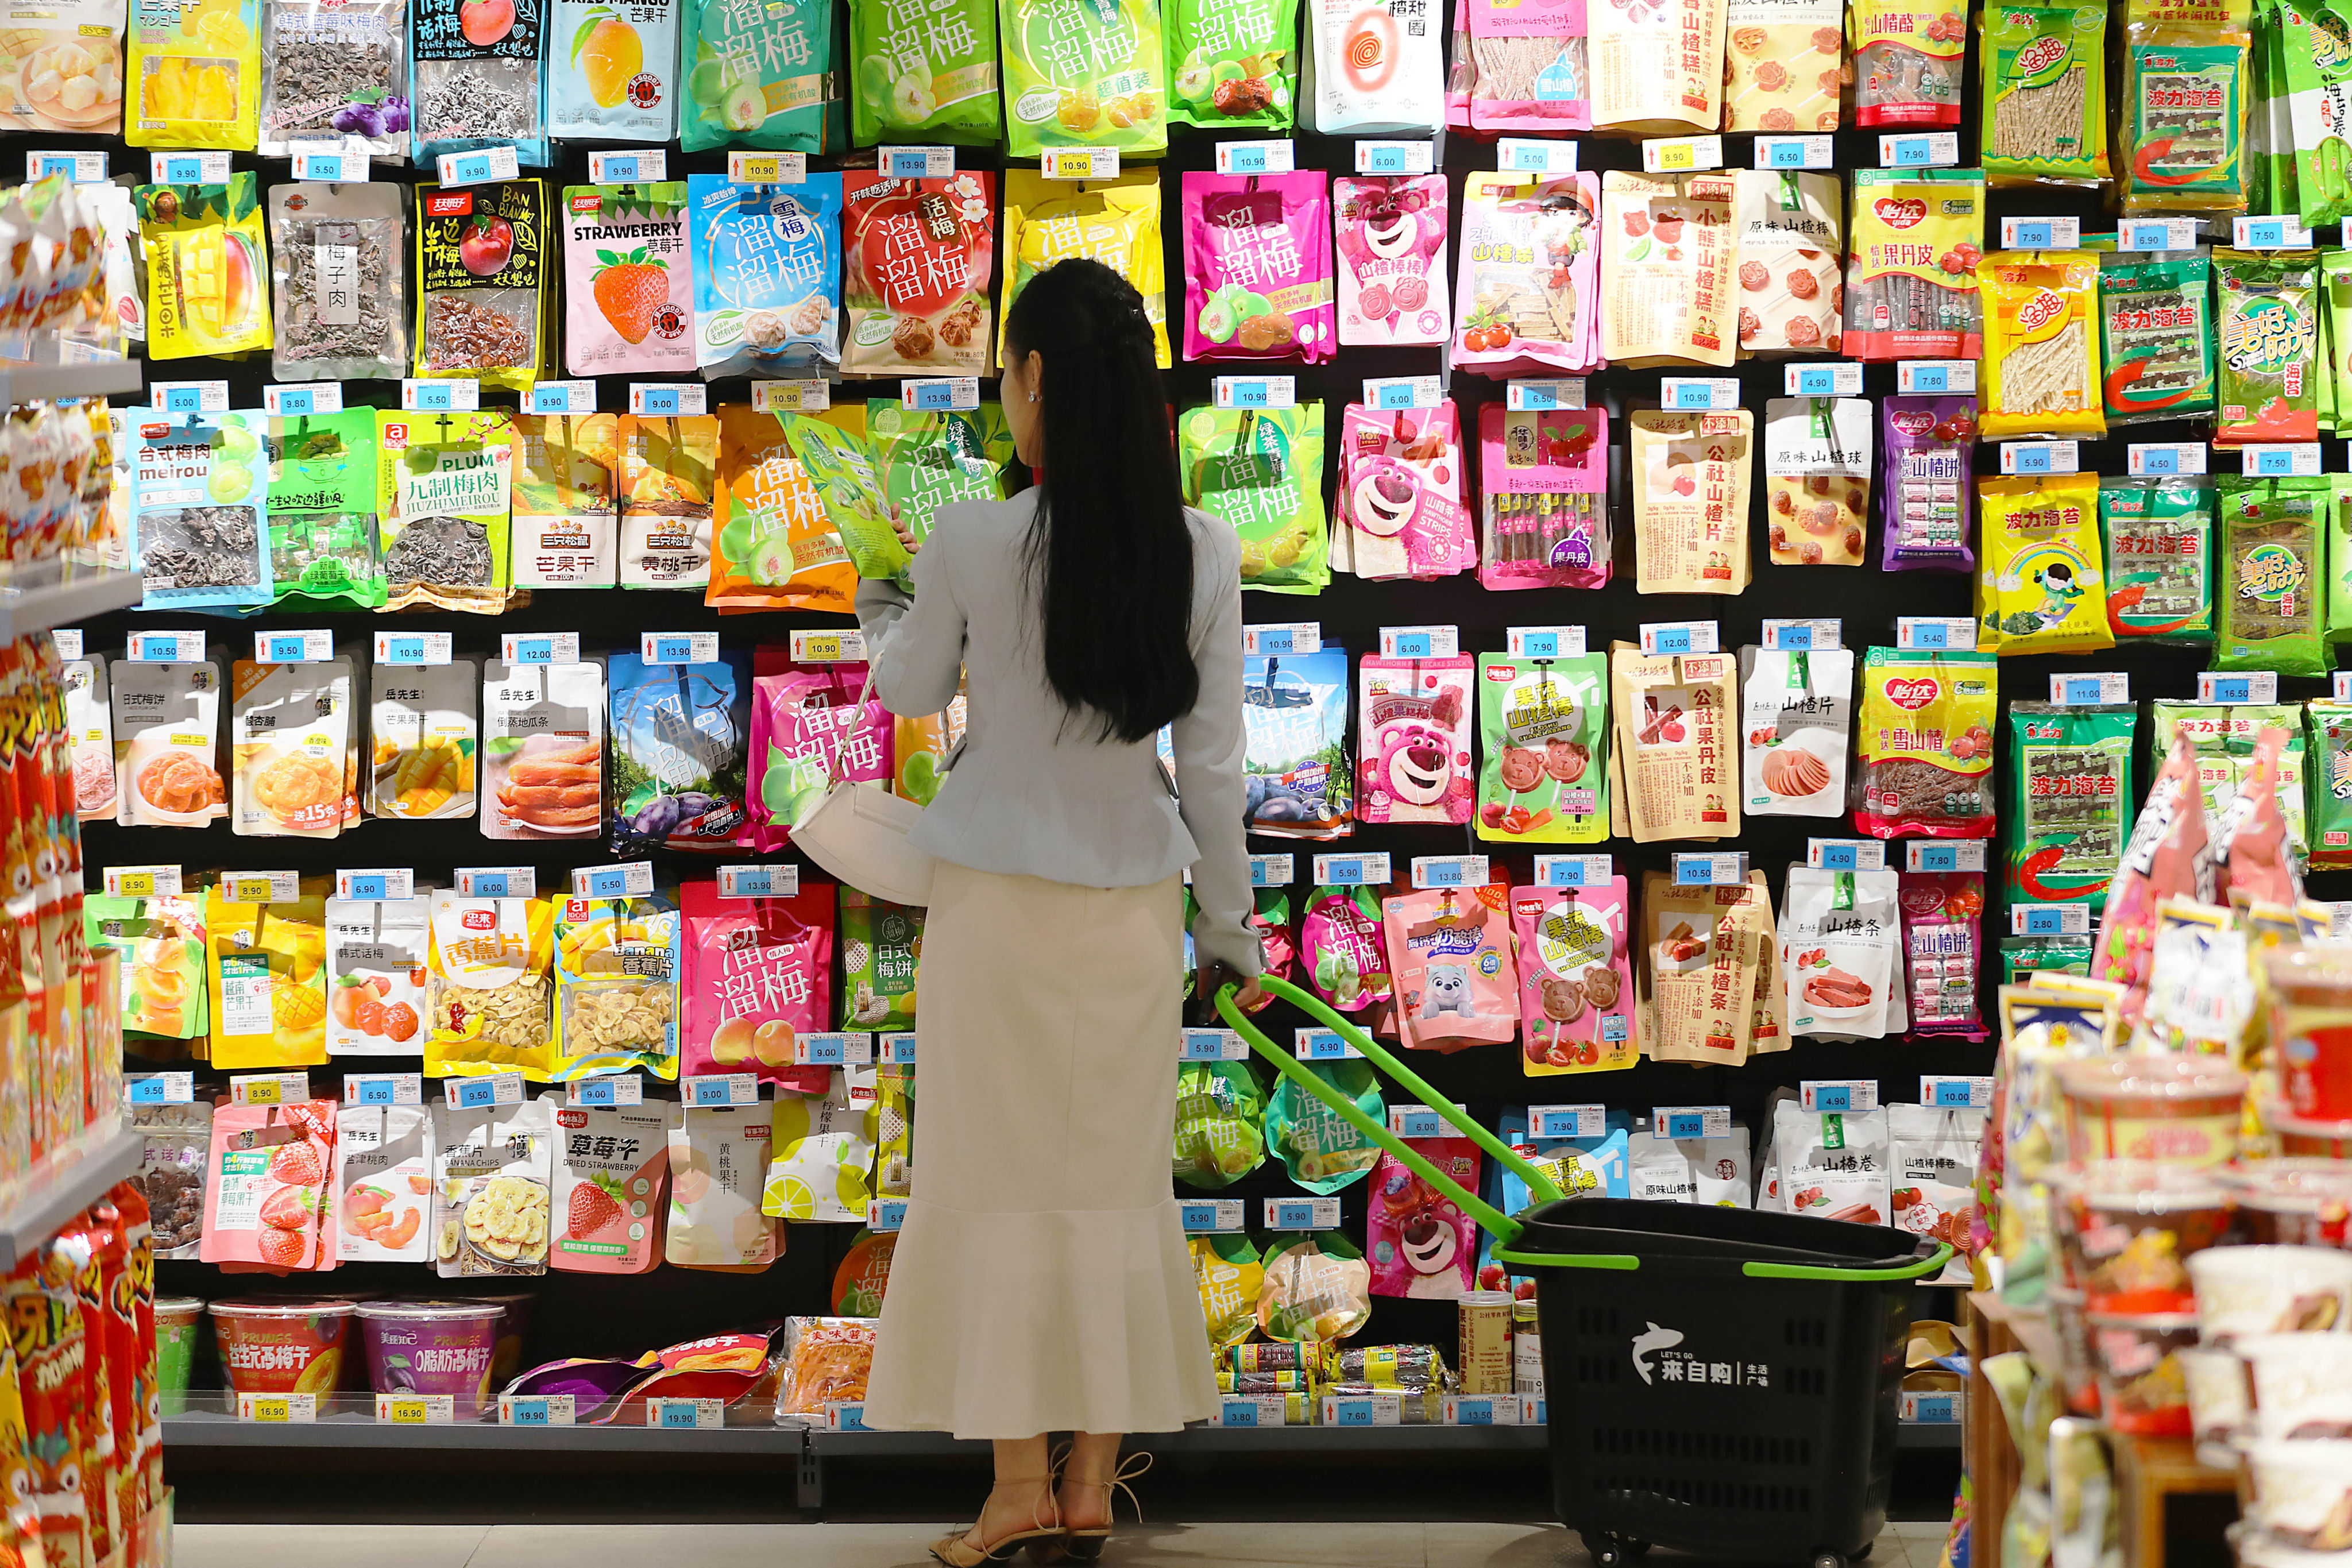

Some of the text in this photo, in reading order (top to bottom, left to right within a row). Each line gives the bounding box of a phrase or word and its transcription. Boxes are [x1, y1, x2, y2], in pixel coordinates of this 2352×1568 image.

[630, 7, 667, 24] 芒果干
[2009, 13, 2034, 25] 波力
[1095, 71, 1152, 99] 超值装
[1540, 78, 1575, 93] 雪山楂
[2149, 88, 2223, 107] 波力海苔
[1523, 155, 1543, 163] 5.00
[1665, 153, 1684, 162] 8.90
[1904, 150, 1924, 159] 7.90
[901, 161, 925, 169] 13.90
[1241, 157, 1265, 167] 10.90
[177, 170, 196, 178] 9.90
[466, 167, 485, 177] 9.90
[750, 167, 774, 175] 10.90
[1693, 183, 1732, 196] 不添加
[502, 186, 530, 206] BAN
[702, 187, 736, 205] 冰爽怡神
[923, 196, 956, 240] 话梅
[574, 222, 682, 240] STRAWBERRY
[1749, 218, 1829, 235] 原味山楂棒
[2139, 236, 2158, 245] 6.90
[2255, 231, 2274, 240] 7.50
[647, 239, 684, 254] 草莓干
[1695, 208, 1714, 313] 小熊山楂糕
[1883, 242, 1933, 268] 果丹皮
[327, 241, 347, 309] 梅子肉
[1360, 258, 1423, 281] 山楂棒棒
[2112, 308, 2195, 330] 波力海苔
[1808, 379, 1826, 387] 4.90
[2285, 362, 2301, 396] 海苔
[286, 399, 306, 408] 9.80
[542, 397, 562, 406] 9.90
[926, 394, 951, 403] 13.90
[1390, 395, 1409, 404] 6.00
[1532, 395, 1551, 403] 6.50
[1359, 430, 1380, 439] TOY
[138, 444, 211, 462] 台式梅肉
[1259, 423, 1286, 473] 绿茶青梅
[442, 454, 493, 472] PLUM
[1913, 458, 1959, 478] 山楂饼
[2025, 458, 2044, 467] 5.90
[2149, 459, 2169, 468] 4.50
[139, 465, 207, 480] meirou
[405, 471, 499, 503] 九制梅肉
[1706, 446, 1725, 542] 公社山楂片
[1426, 496, 1454, 517] 山楂条
[1423, 508, 1453, 526] HAWTHORN
[1419, 516, 1451, 536] STRIPS
[2115, 536, 2199, 554] 波力海苔
[797, 547, 844, 563] 天然有机酸
[536, 555, 595, 572] 芒果干
[641, 555, 700, 572] 黄桃干
[310, 570, 346, 580] 绿葡萄干
[1789, 636, 1808, 644] 4.90
[1924, 634, 1942, 643] 5.40
[152, 647, 176, 655] 10.50
[399, 649, 424, 657] 10.90
[812, 644, 836, 652] 10.90
[1401, 644, 1420, 653] 6.00
[1533, 643, 1552, 651] 7.90
[527, 650, 550, 659] 12.00
[1369, 681, 1389, 690] TOY
[1893, 685, 1932, 698] 怡达
[123, 693, 165, 706] 日式梅饼
[385, 689, 419, 700] 岳先生
[2224, 689, 2249, 698] 16.50
[1782, 696, 1834, 715] 山楂片
[385, 715, 429, 725] 芒果果干
[1507, 701, 1573, 729] 山楂棒
[497, 716, 549, 728] 倒蒸地瓜条
[1694, 689, 1716, 784] 公社果丹皮
[2038, 727, 2063, 739] 波力
[1893, 728, 1944, 751] 雪山楂
[2031, 775, 2117, 795] 波力海苔
[294, 804, 337, 821] 送15克
[1929, 856, 1949, 864] 7.80
[1339, 868, 1357, 877] 5.90
[1438, 872, 1462, 881] 13.80
[1687, 869, 1711, 878] 10.50
[242, 887, 262, 895] 8.90
[356, 885, 374, 893] 6.90
[602, 880, 620, 890] 5.50
[339, 925, 370, 935] 岳先生
[1545, 910, 1587, 938] 果蔬
[1827, 918, 1880, 937] 山楂条
[2033, 920, 2052, 929] 2.80
[1543, 926, 1604, 962] 山楂棒
[1922, 933, 1967, 953] 山楂饼
[445, 933, 524, 967] 香蕉片
[614, 945, 674, 959] Banana
[769, 947, 791, 957] 情人梅
[878, 943, 911, 959] 日式
[1558, 951, 1605, 974] SHANZHABANG
[1566, 951, 1592, 963] GUOSHU
[623, 958, 673, 977] 香蕉片
[1710, 916, 1736, 1011] 公社山楂条
[878, 962, 912, 978] 梅饼
[225, 982, 244, 995] 越南
[225, 997, 254, 1011] 芒果干
[817, 1049, 836, 1057] 9.00
[1319, 1043, 1338, 1052] 5.90
[252, 1089, 271, 1098] 8.90
[469, 1091, 488, 1100] 9.50
[587, 1090, 606, 1098] 9.00
[1945, 1093, 1969, 1101] 10.00
[817, 1100, 835, 1148] 柠檬果干
[1416, 1123, 1435, 1131] 6.00
[1679, 1123, 1699, 1131] 9.50
[347, 1131, 377, 1142] 岳先生
[445, 1144, 484, 1158] 香蕉片
[569, 1135, 639, 1161] 草莓干
[346, 1154, 388, 1166] 盐津桃肉
[563, 1159, 639, 1171] DRIED STRAWBERRY
[1822, 1155, 1877, 1172] 山楂卷
[1906, 1158, 1956, 1168] 山楂棒棒卷
[718, 1143, 731, 1195] 黄桃果干
[1646, 1183, 1697, 1195] 原味山楂棒
[221, 1192, 253, 1206] 草莓果干
[1190, 1214, 1209, 1222] 5.90
[242, 1332, 292, 1344] PRUNES
[1662, 1360, 1731, 1385] 来自购
[1747, 1364, 1768, 1374] 生活
[1747, 1376, 1768, 1387] 广场
[260, 1408, 284, 1416] 16.90
[520, 1412, 544, 1420] 19.90
[1347, 1412, 1366, 1420] 7.60
[1926, 1408, 1951, 1417] 12.00
[669, 1415, 693, 1423] 19.90
